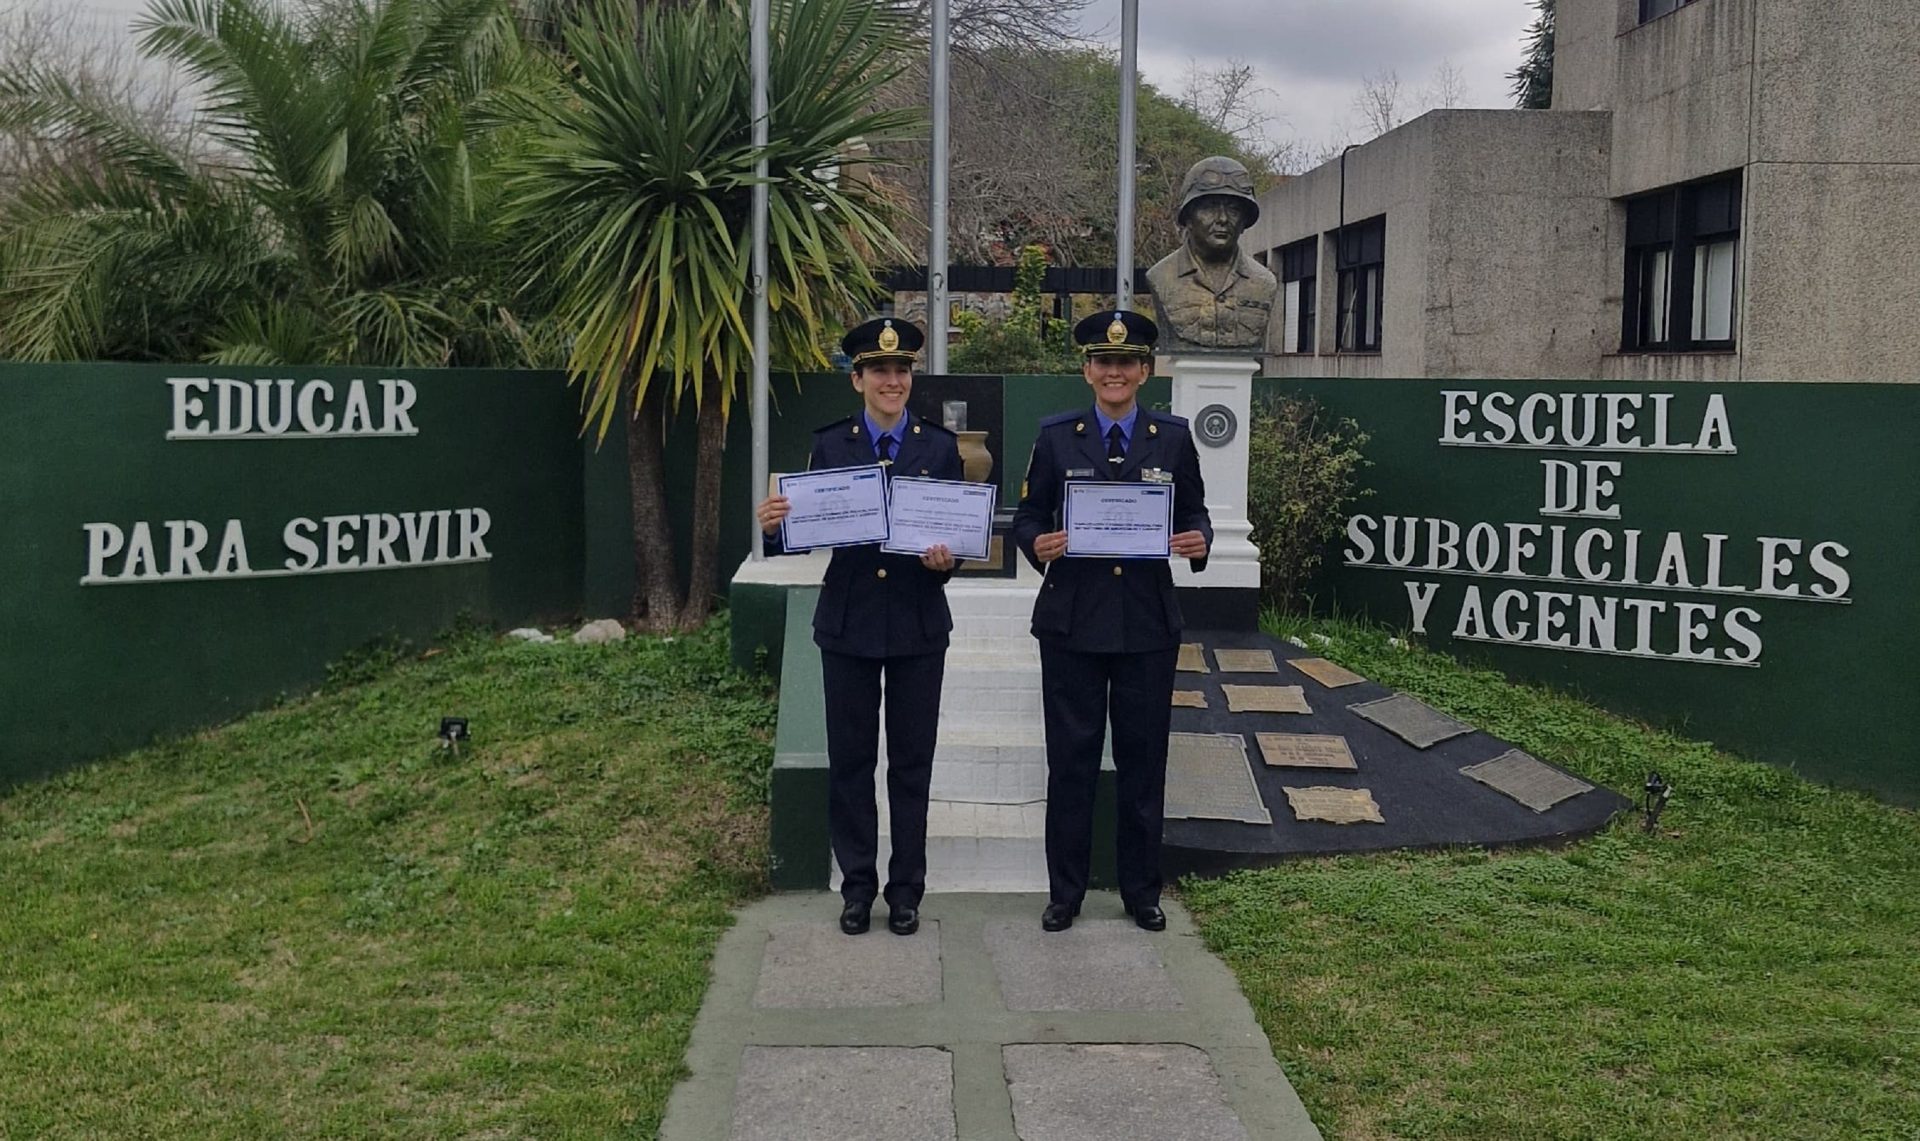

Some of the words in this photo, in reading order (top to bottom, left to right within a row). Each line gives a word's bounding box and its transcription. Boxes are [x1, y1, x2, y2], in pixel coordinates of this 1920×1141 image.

[166, 378, 418, 436] EDUCAR
[1440, 390, 1736, 451] ESCUELA
[1540, 459, 1622, 516] DE
[82, 519, 252, 580] PARA
[283, 508, 492, 572] SERVIR
[1343, 514, 1851, 599] SUBOFICIALES
[1404, 581, 1440, 635] Y
[1453, 585, 1763, 664] AGENTES
